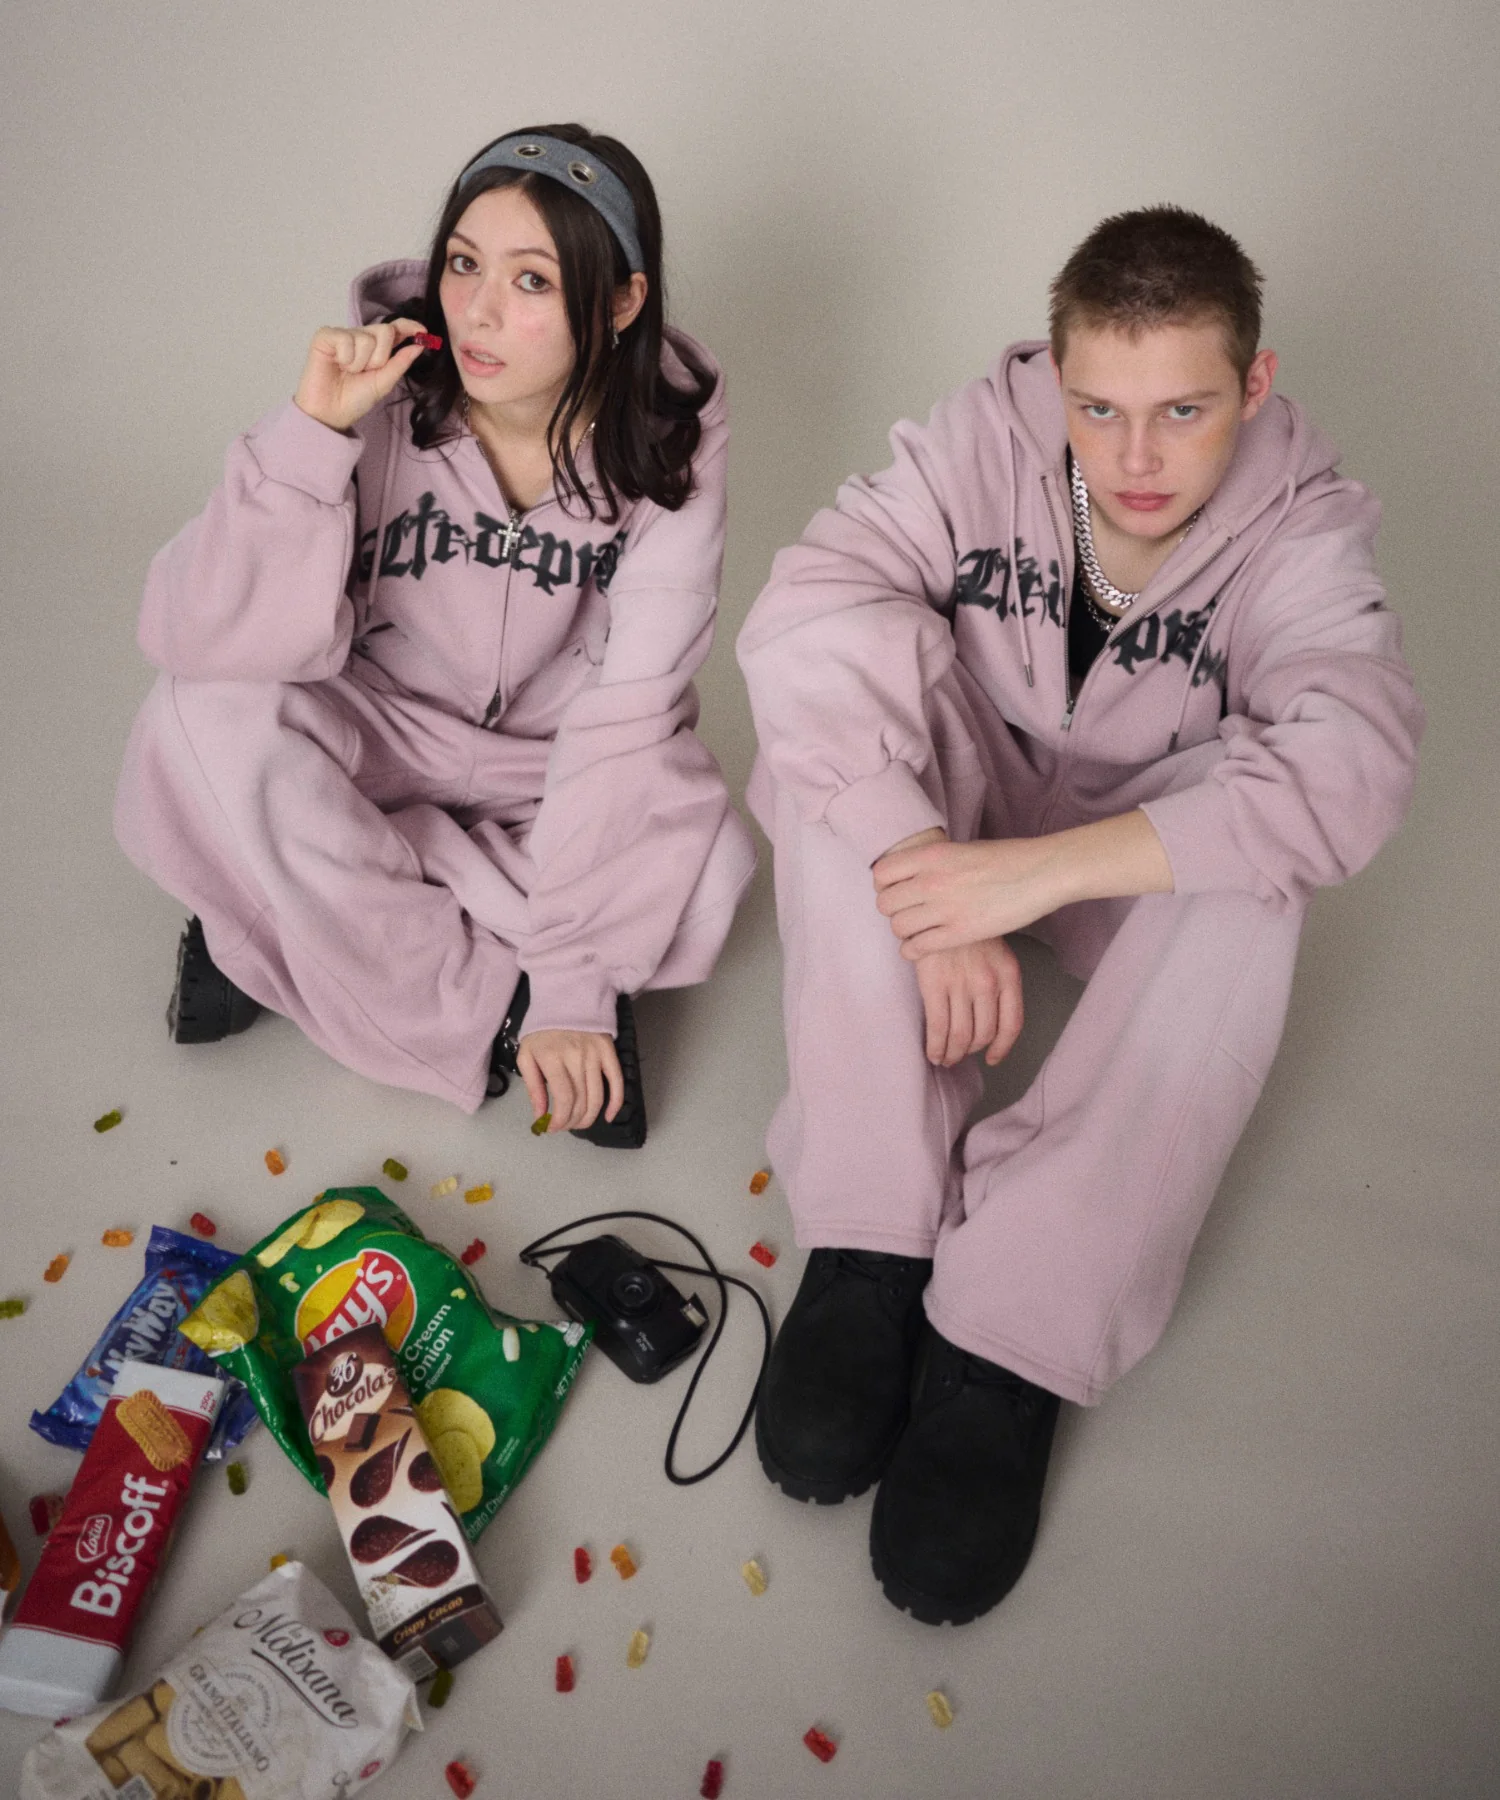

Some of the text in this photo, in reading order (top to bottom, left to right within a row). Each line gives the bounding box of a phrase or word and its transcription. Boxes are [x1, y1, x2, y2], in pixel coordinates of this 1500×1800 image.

[405, 1304, 451, 1362] Cream
[413, 1328, 455, 1381] Onion
[330, 1353, 358, 1391] 36
[308, 1366, 398, 1446] Chocola's
[69, 1472, 167, 1617] Biscoff
[81, 1518, 105, 1556] Lotus
[463, 1510, 489, 1540] otato
[393, 1617, 426, 1645] Crispy
[428, 1596, 464, 1621] Cacao
[233, 1608, 359, 1729] Molisana
[189, 1663, 225, 1708] GRANO
[219, 1704, 270, 1773] ITALIANO
